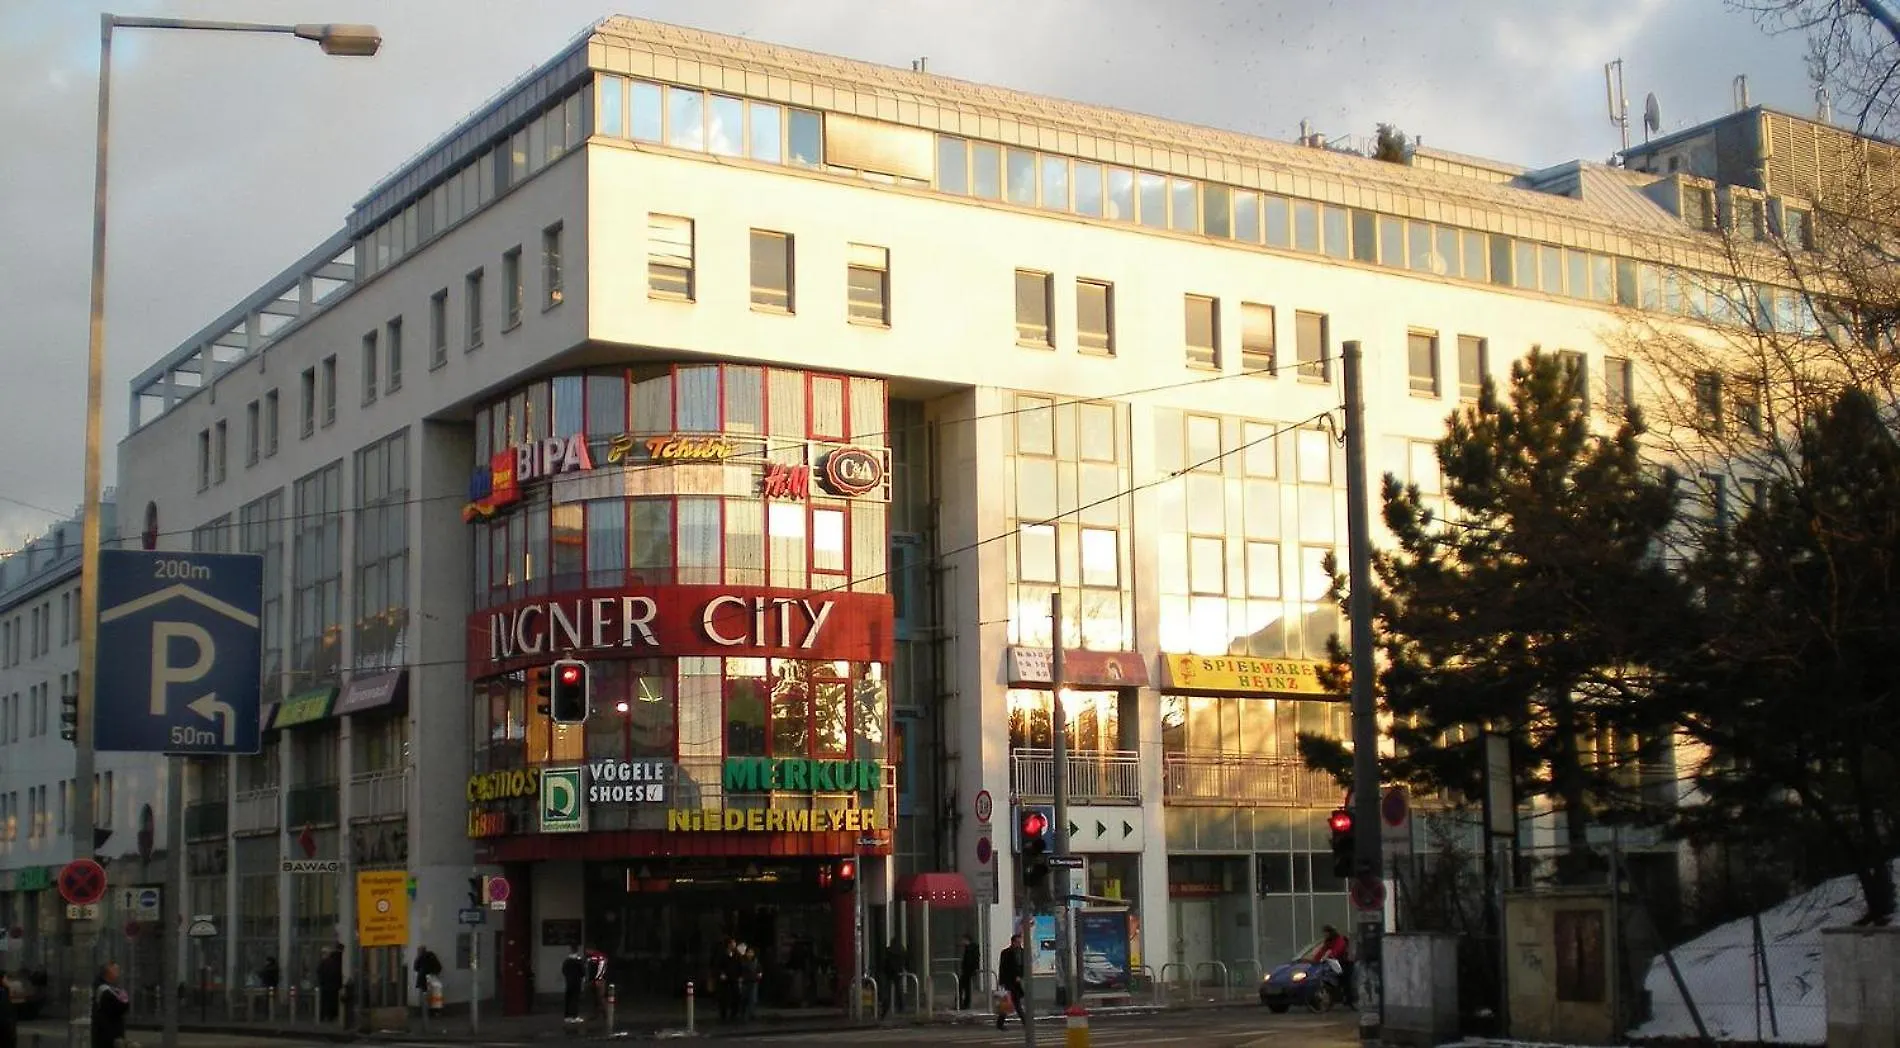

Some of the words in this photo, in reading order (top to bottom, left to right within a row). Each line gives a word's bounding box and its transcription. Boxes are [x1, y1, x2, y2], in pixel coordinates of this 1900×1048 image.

[517, 433, 592, 481] BIPA
[841, 458, 877, 480] C&A
[764, 463, 808, 499] H&M
[155, 560, 210, 579] 200m
[703, 595, 835, 648] CITY
[150, 621, 215, 715] P
[1203, 659, 1312, 676] SPIELWARE
[1240, 675, 1298, 690] HEINZ
[171, 726, 216, 745] 50m
[725, 758, 880, 791] MERKUR
[589, 785, 644, 802] SHOES
[283, 862, 338, 872] BAWAG
